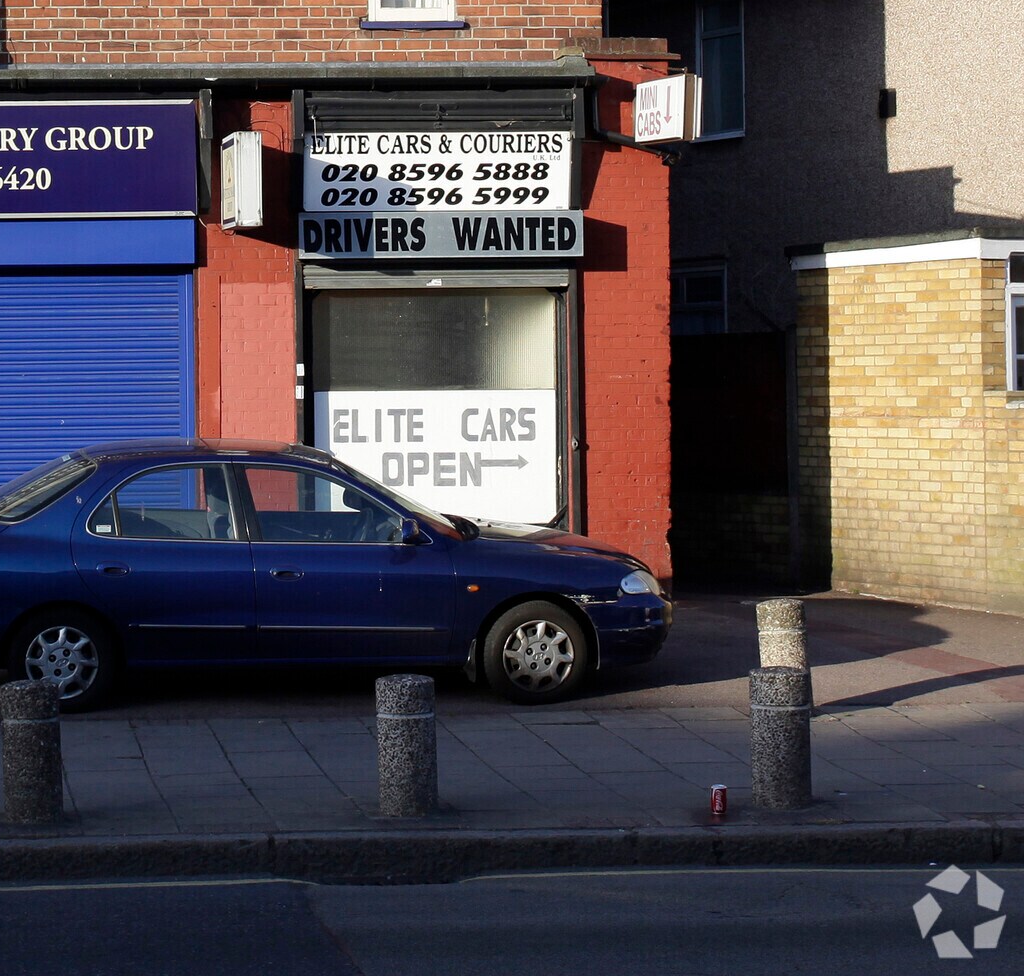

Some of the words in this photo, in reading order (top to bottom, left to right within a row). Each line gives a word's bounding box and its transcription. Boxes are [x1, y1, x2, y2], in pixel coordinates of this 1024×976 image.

[640, 85, 658, 112] MINI
[637, 110, 661, 137] CABS
[44, 125, 154, 152] GROUP
[311, 134, 370, 155] ELITE
[377, 134, 432, 155] CARS
[438, 134, 453, 154] &
[460, 133, 563, 154] COURIERS
[321, 163, 378, 183] 020
[387, 163, 463, 182] 8596
[472, 162, 550, 181] 5888
[320, 187, 378, 207] 020
[387, 187, 463, 206] 8596
[472, 186, 550, 205] 5999
[303, 218, 426, 254] DRIVERS
[452, 217, 577, 253] WANTED
[333, 408, 424, 444] ELITE
[461, 407, 536, 442] CARS
[382, 451, 482, 487] OPEN
